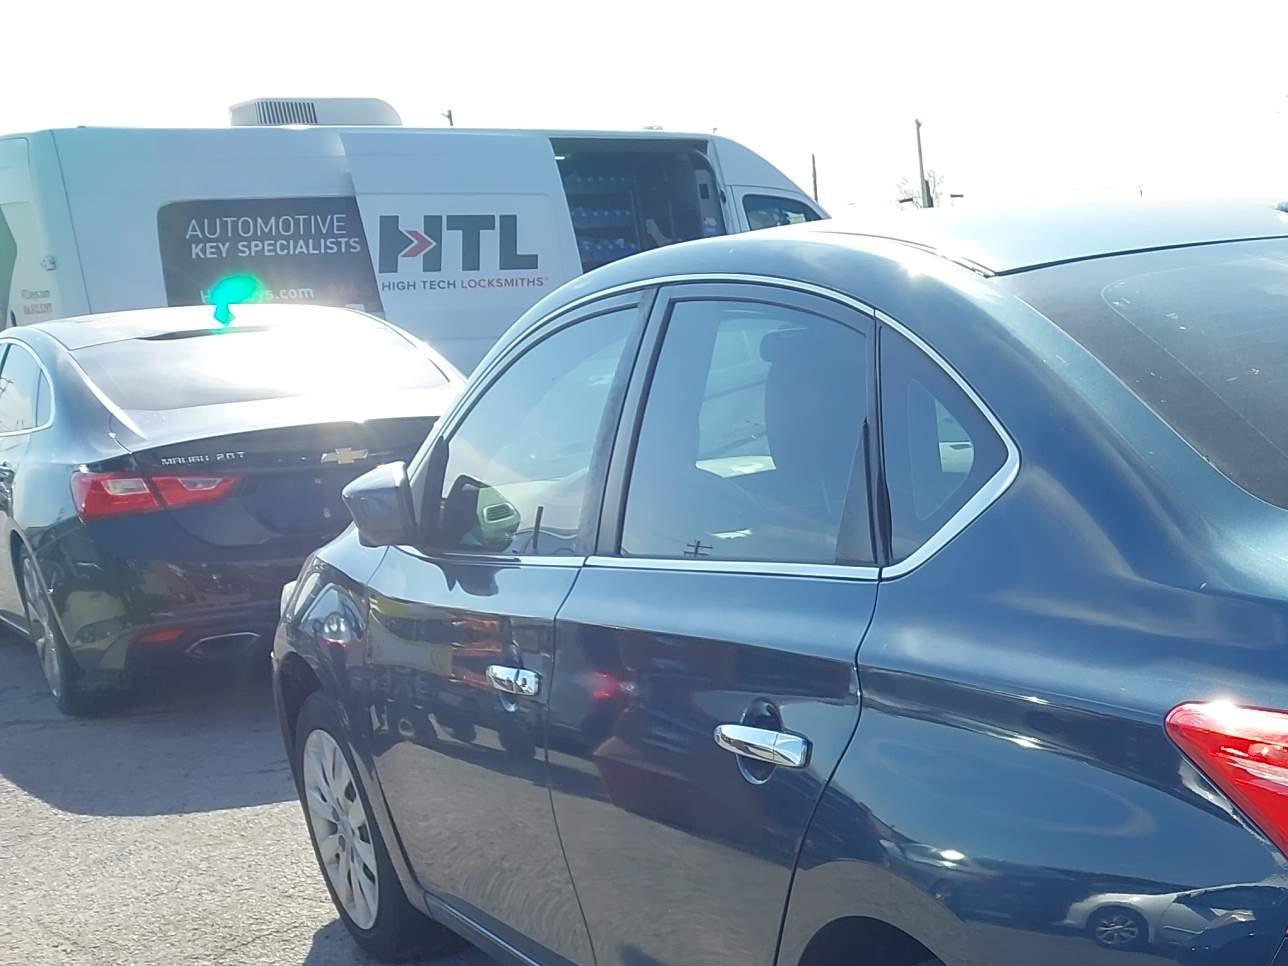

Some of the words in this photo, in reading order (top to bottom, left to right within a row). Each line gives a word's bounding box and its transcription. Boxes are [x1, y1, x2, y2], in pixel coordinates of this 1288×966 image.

[186, 214, 347, 240] AUTOMOTIVE
[191, 242, 230, 259] KEY
[237, 238, 361, 257] SPECIALISTS
[378, 214, 539, 274] HTL
[382, 280, 417, 292] HIGH
[420, 279, 457, 291] TECH
[460, 276, 545, 289] LOCKSMITHS
